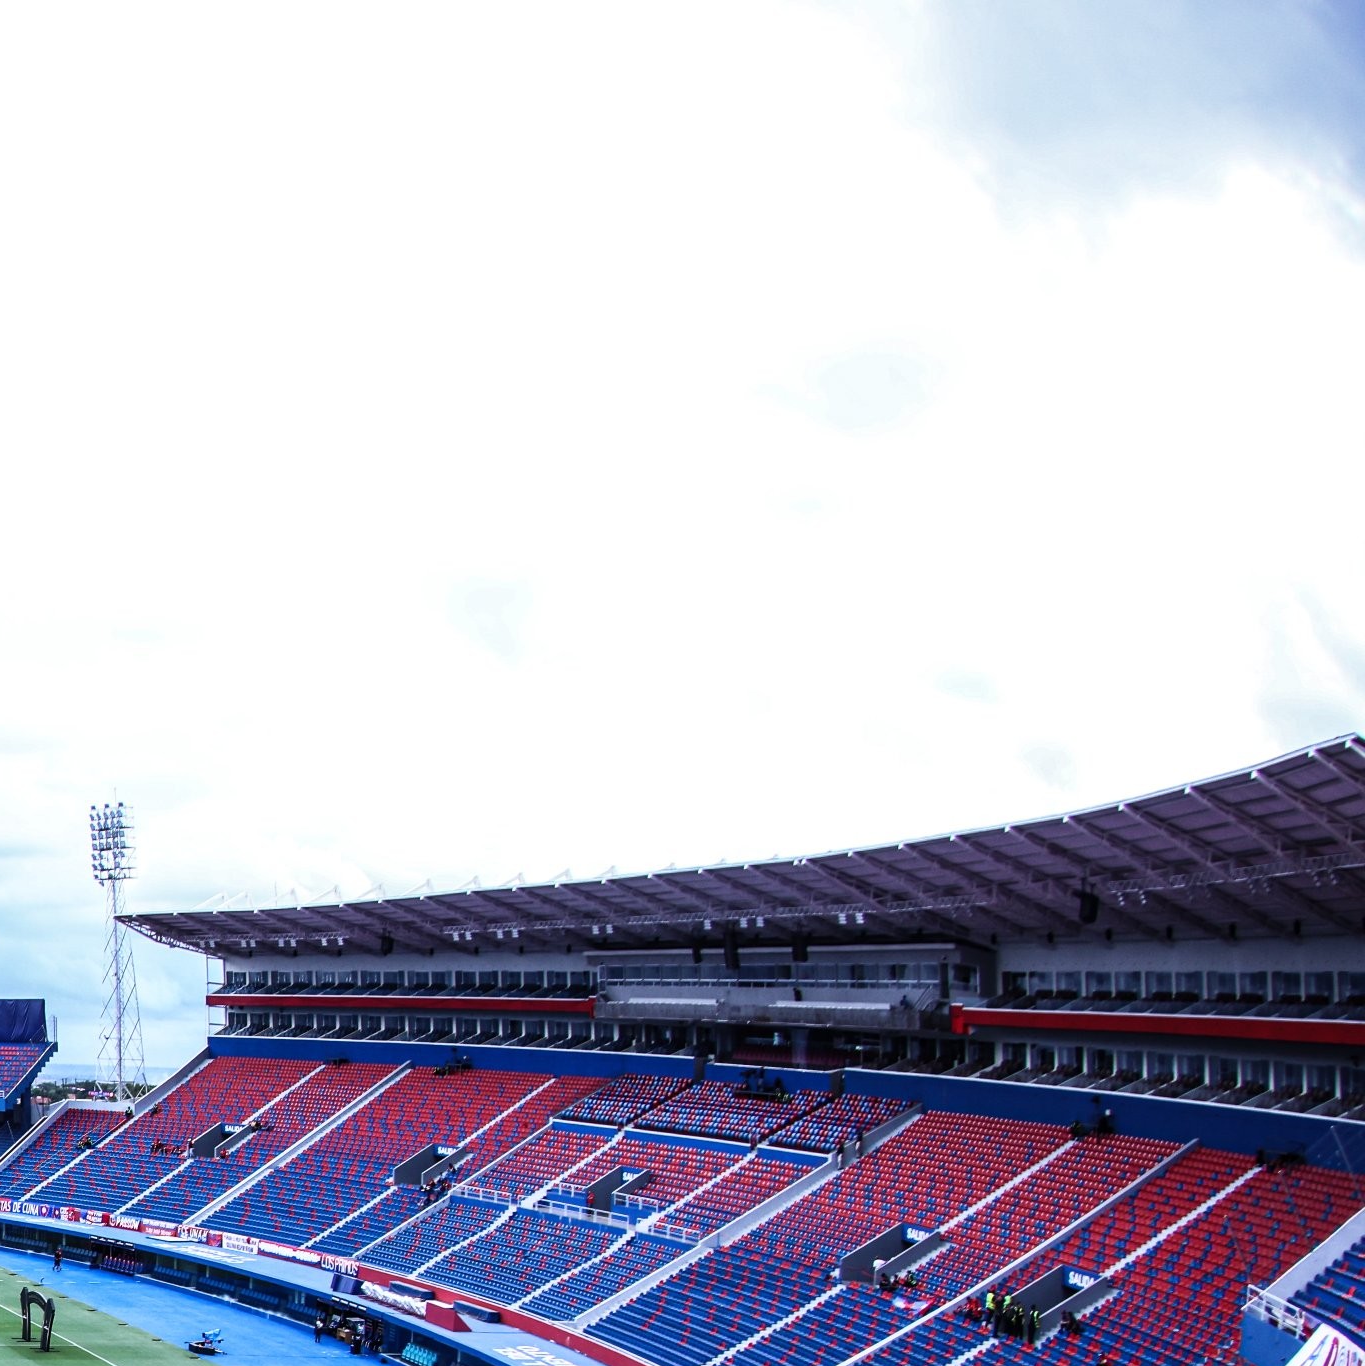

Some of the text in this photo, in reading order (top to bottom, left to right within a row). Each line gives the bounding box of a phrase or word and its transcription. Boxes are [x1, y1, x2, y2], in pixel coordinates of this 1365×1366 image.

[12, 1201, 21, 1213] DE
[22, 1202, 39, 1216] CUNA
[321, 1253, 359, 1276] LOS PRIMOS
[1069, 1271, 1095, 1288] SALIDA
